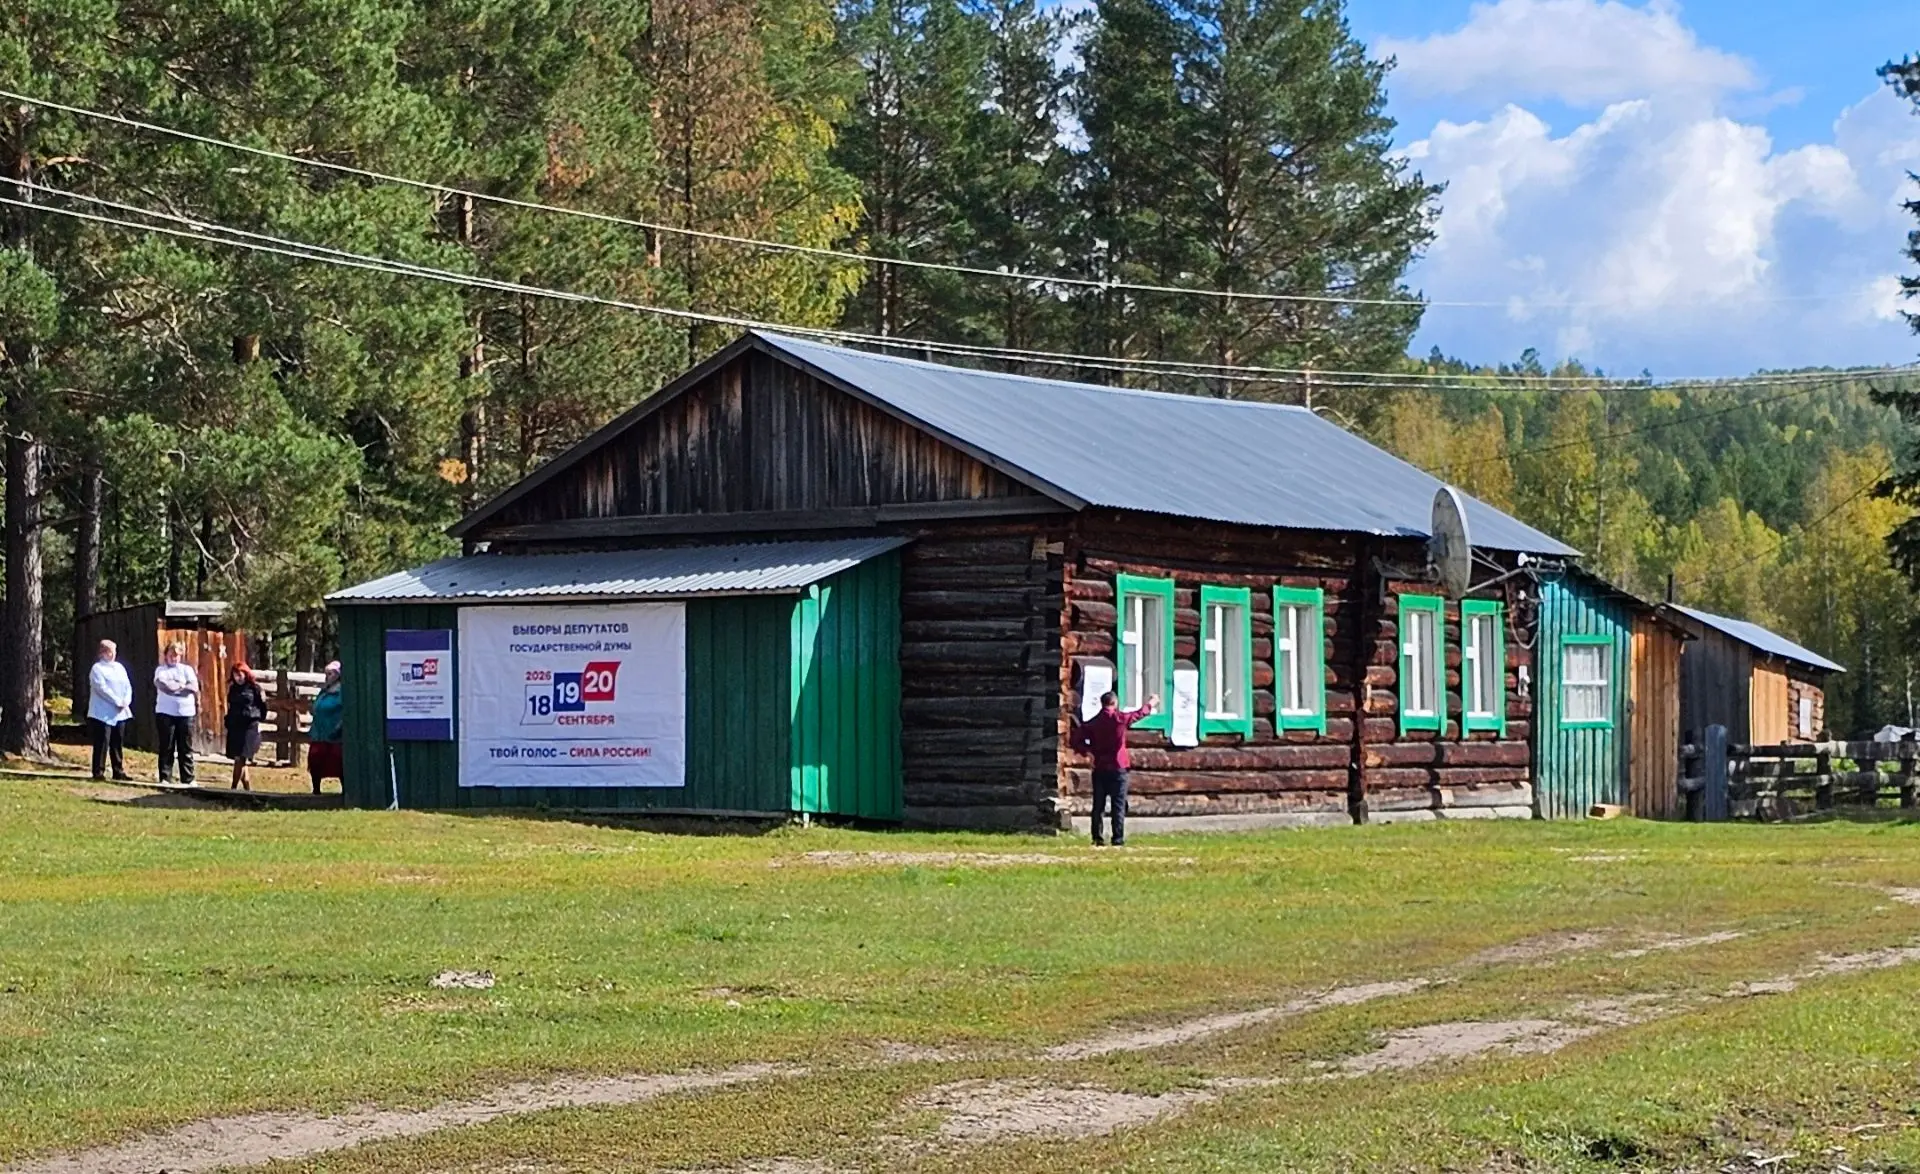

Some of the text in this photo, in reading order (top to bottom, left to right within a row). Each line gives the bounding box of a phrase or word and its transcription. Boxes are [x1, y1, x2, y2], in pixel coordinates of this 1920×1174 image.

[512, 623, 629, 635] ВЫБОРЫ ДЕПУТАТОВ
[509, 642, 632, 653] ГОСУДАРСТВЕННОЙ ДУМЫ
[525, 671, 552, 681] 2026
[528, 671, 613, 716] 18 19 20
[557, 715, 615, 725] СЕНТЯБРЯ
[489, 747, 519, 759] ТВОЙ
[521, 748, 557, 758] ГОЛОС
[569, 748, 602, 758] СИЛА
[603, 748, 652, 758] РОССИИ!
